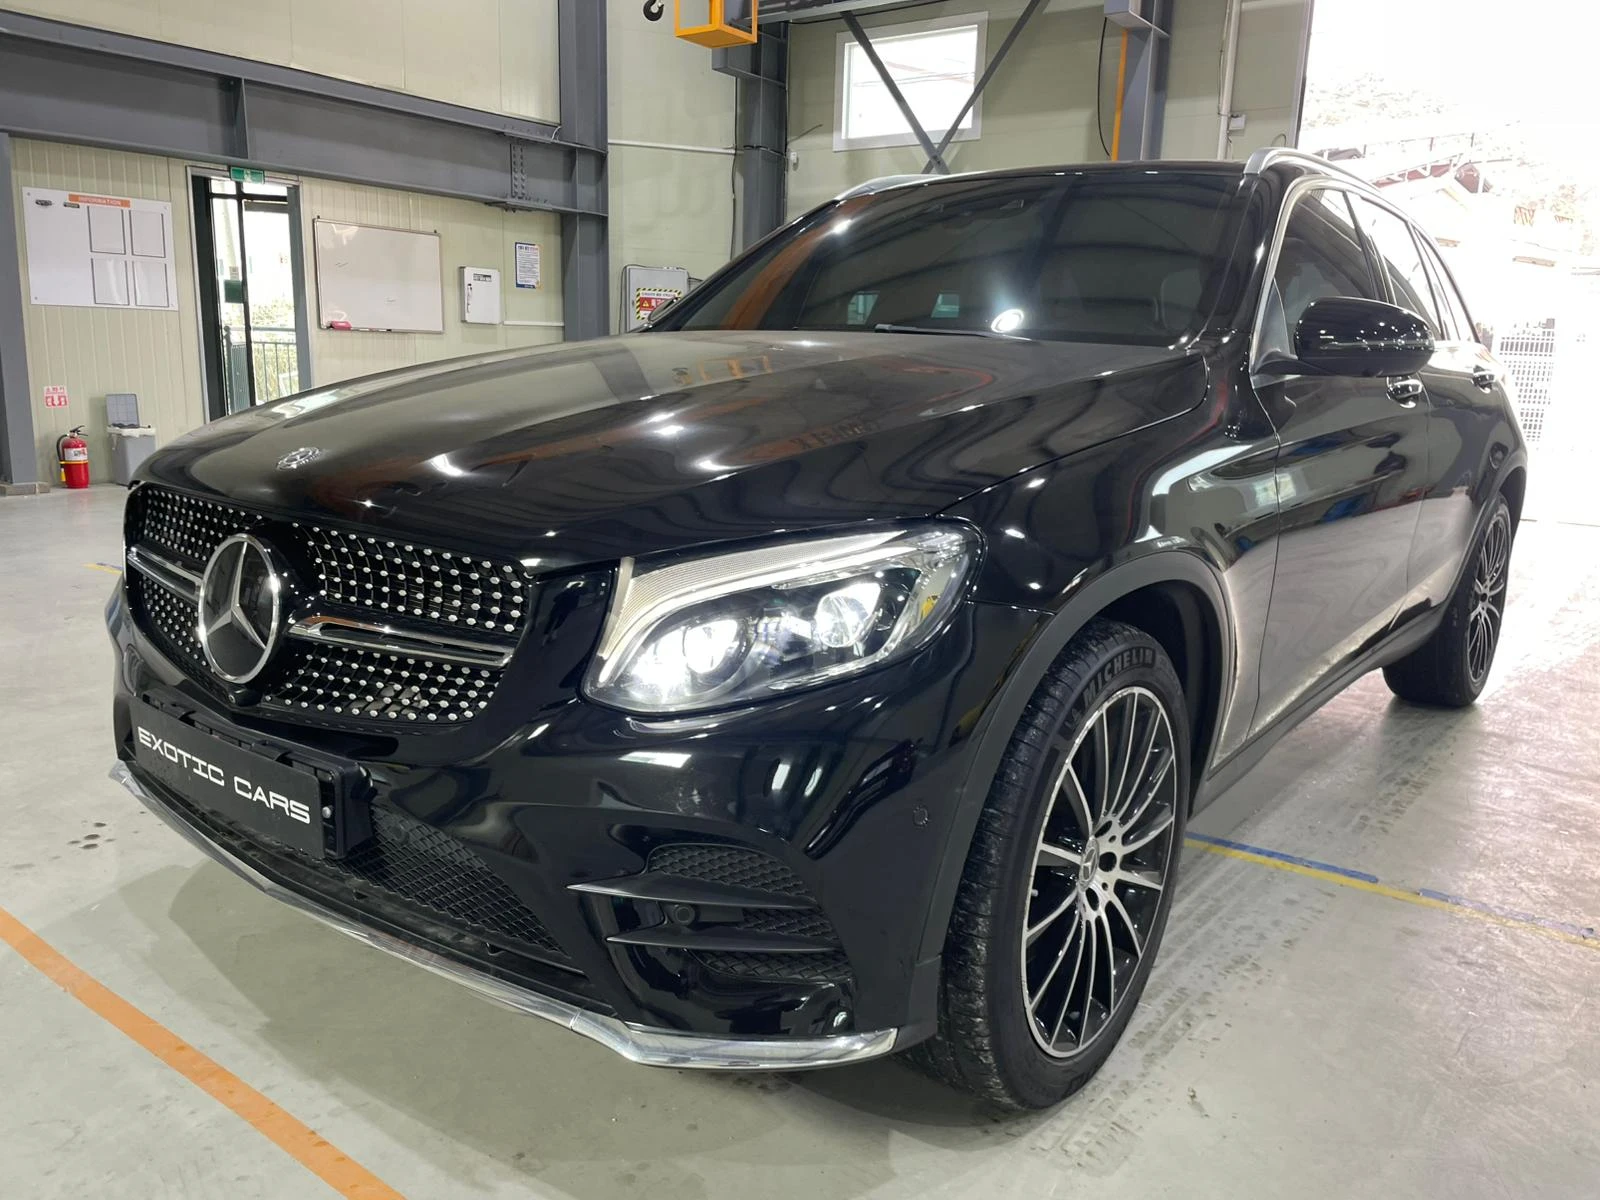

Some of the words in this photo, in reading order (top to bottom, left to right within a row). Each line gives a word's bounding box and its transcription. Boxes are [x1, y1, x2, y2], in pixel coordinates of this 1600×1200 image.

[1083, 647, 1154, 707] MICHELIN
[137, 726, 225, 786] EXOTIC
[233, 776, 311, 825] CARS
